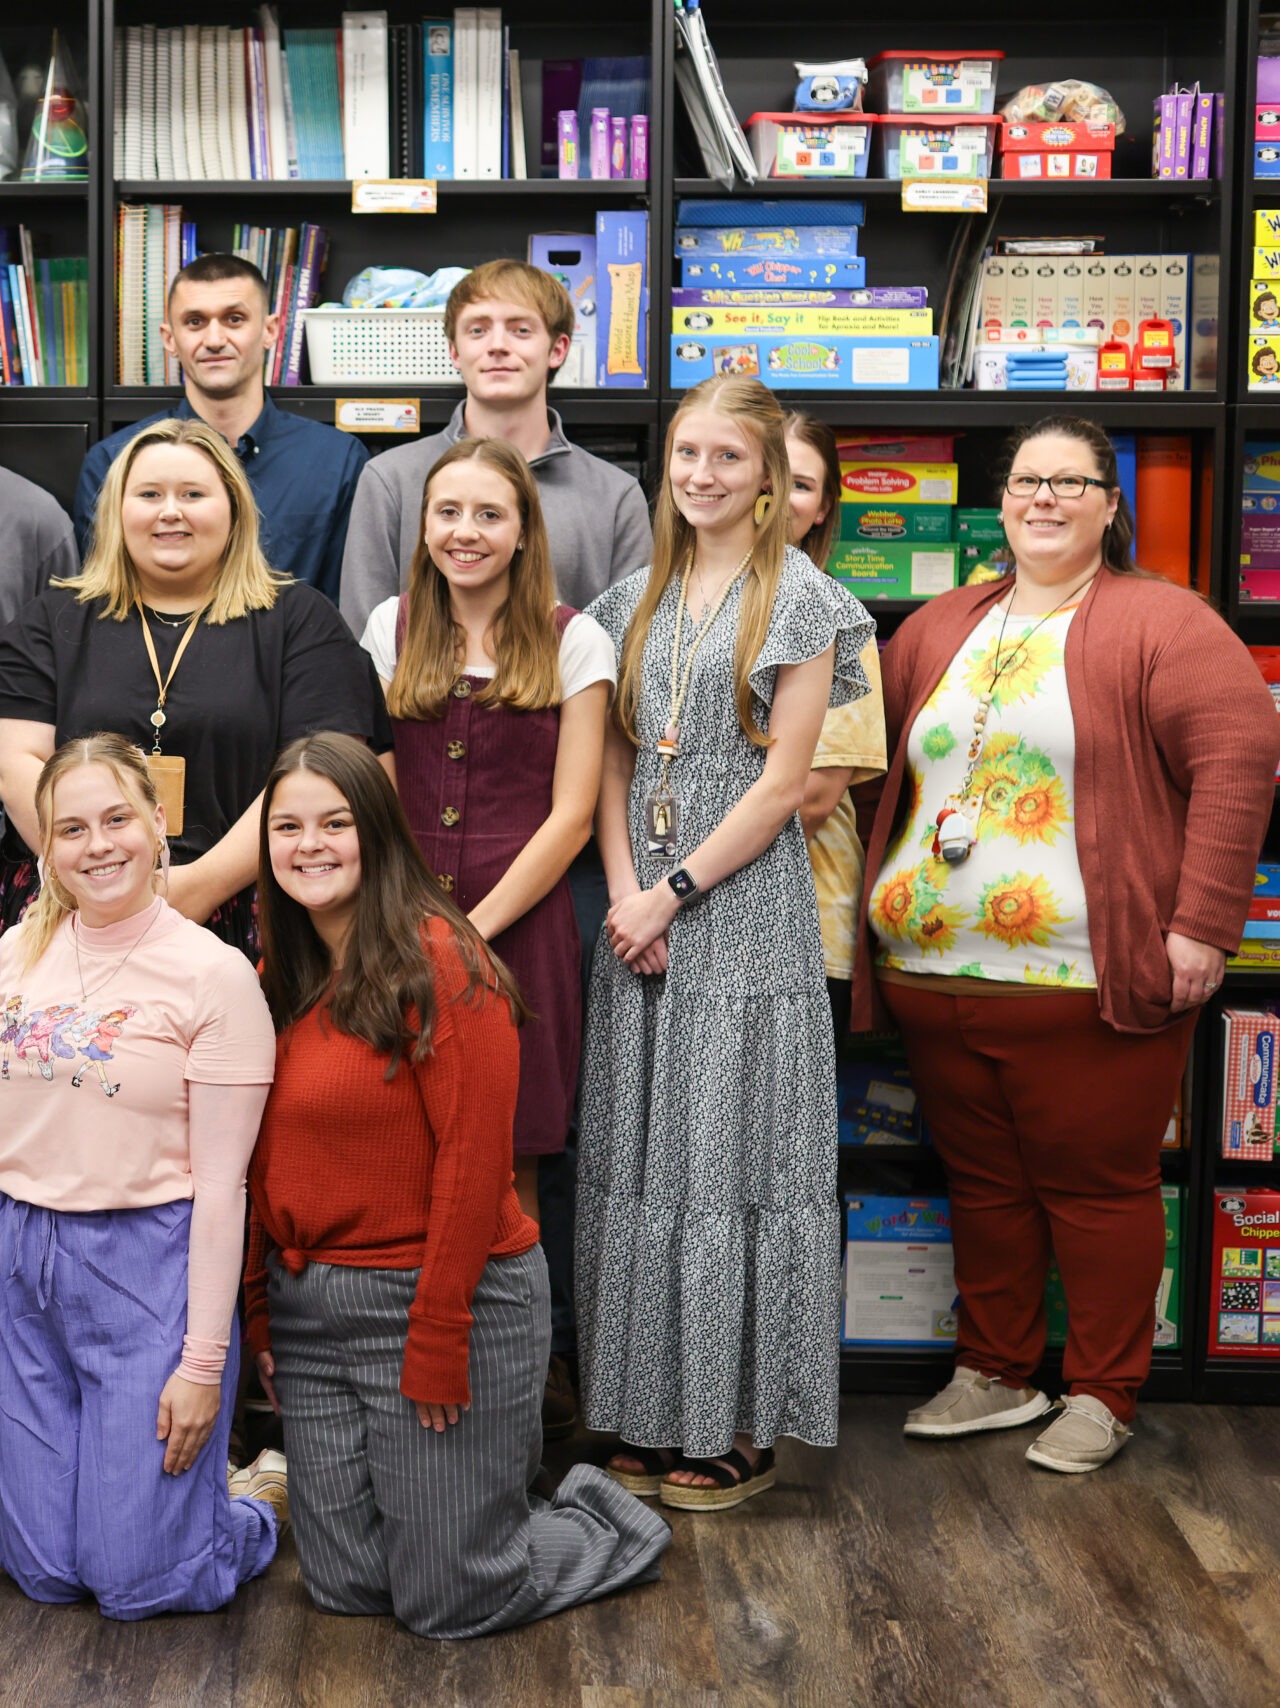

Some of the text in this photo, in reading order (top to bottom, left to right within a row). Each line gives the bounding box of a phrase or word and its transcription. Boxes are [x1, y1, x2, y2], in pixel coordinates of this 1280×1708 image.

[441, 73, 450, 92] ONE
[430, 73, 440, 143] REMEMBERS
[1265, 251, 1280, 269] W
[297, 268, 311, 297] MAPS
[623, 271, 636, 368] Treasure Hunt Map
[725, 313, 805, 325] See it, Say it
[289, 309, 305, 373] OGRAPHY
[614, 328, 623, 354] World
[788, 343, 811, 355] Cool
[785, 357, 822, 369] School
[846, 477, 910, 488] Problem Solving
[861, 517, 903, 525] Photo Lotto
[868, 510, 897, 518] Webber
[836, 562, 894, 570] Communication
[845, 555, 866, 563] Story
[1258, 1035, 1272, 1105] Communicate
[864, 1209, 919, 1233] Wordy
[1233, 1210, 1280, 1227] Social
[1240, 1226, 1280, 1239] Chippe
